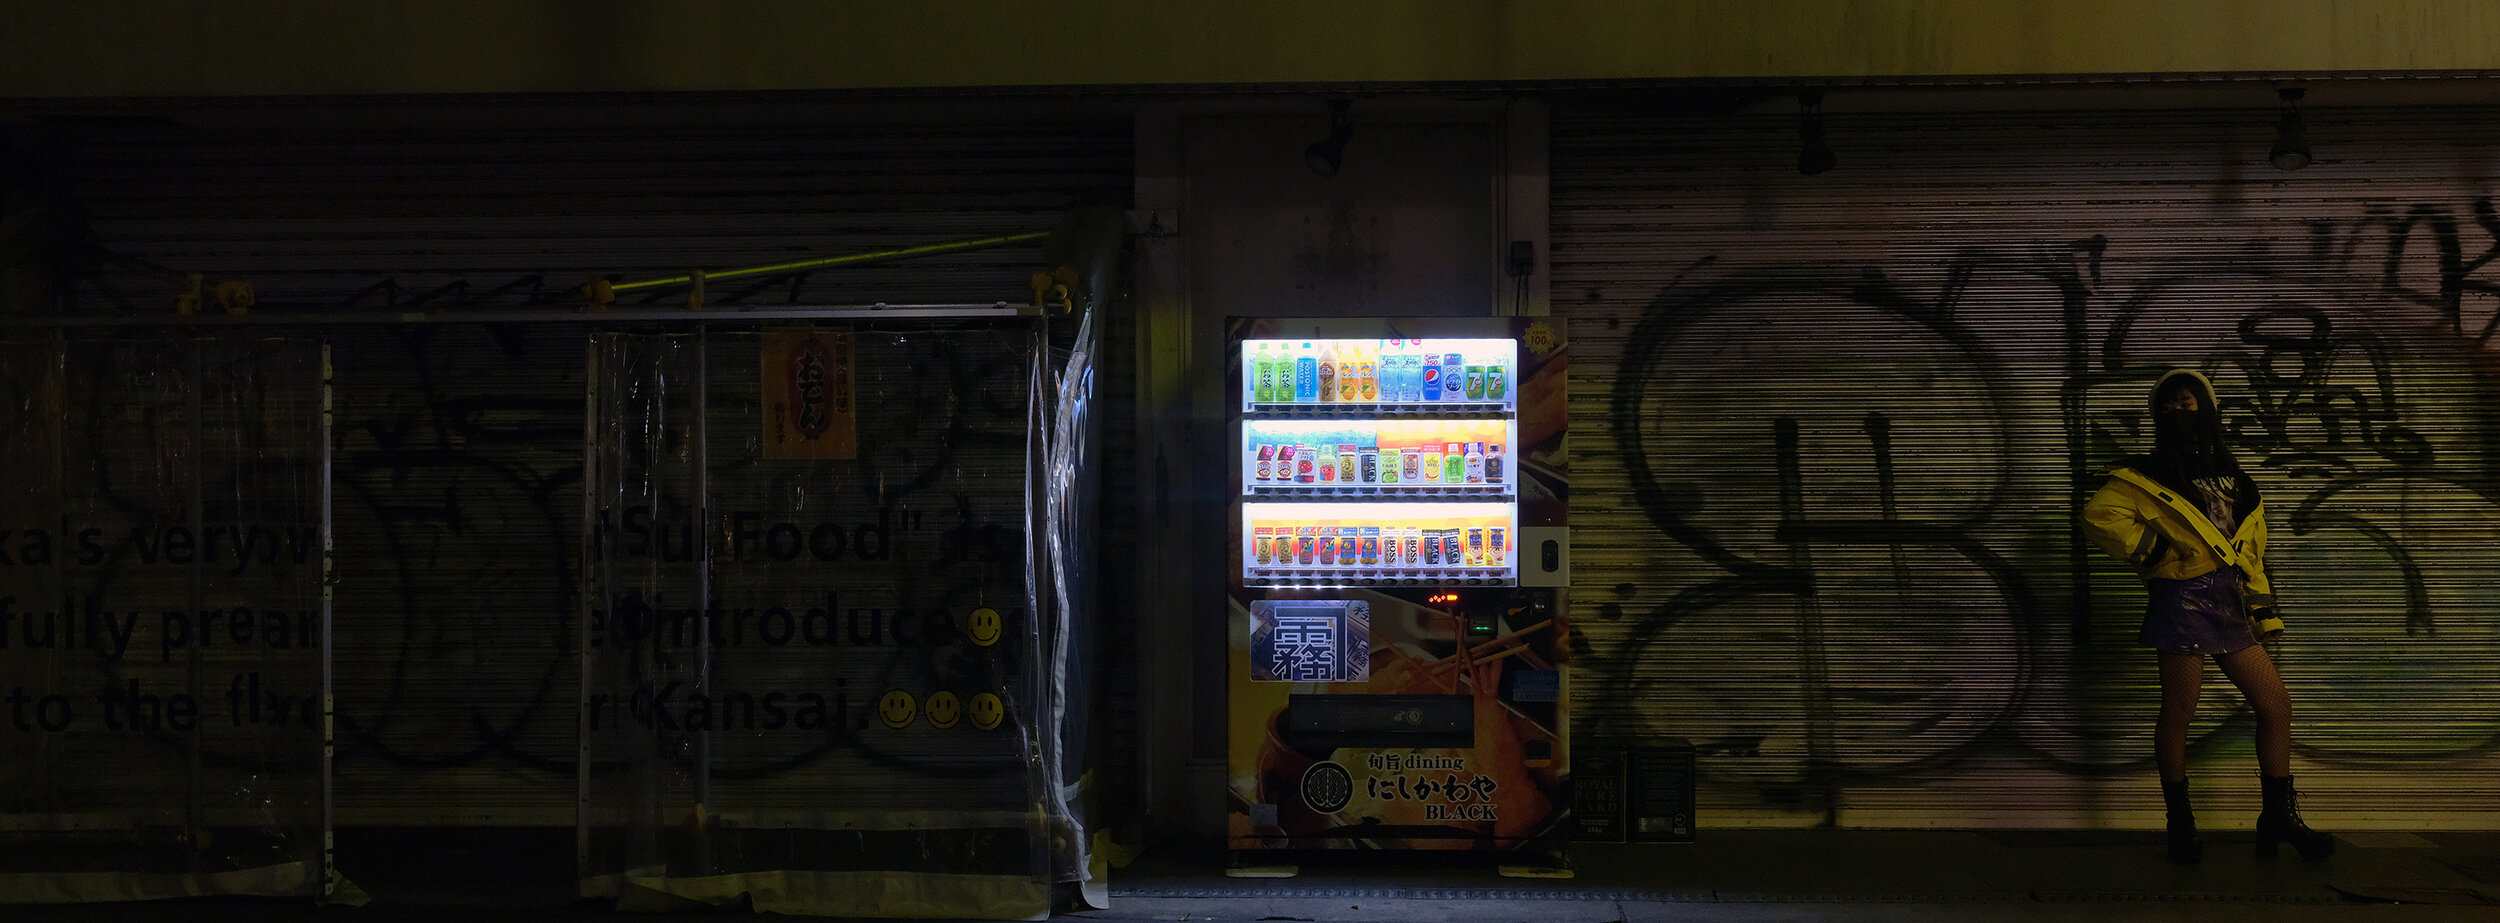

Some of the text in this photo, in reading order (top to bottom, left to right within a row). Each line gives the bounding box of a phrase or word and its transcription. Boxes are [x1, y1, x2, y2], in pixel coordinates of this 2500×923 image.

[1368, 455, 1376, 482] BLACK
[1449, 536, 1460, 564] BLACK
[6, 687, 72, 732] to
[98, 679, 199, 731] the
[1404, 754, 1465, 771] dining
[1367, 774, 1497, 801] にしかわや
[1574, 779, 1617, 790] ROYAL
[1425, 805, 1497, 821] BLACK
[1574, 801, 1618, 812] LARD
